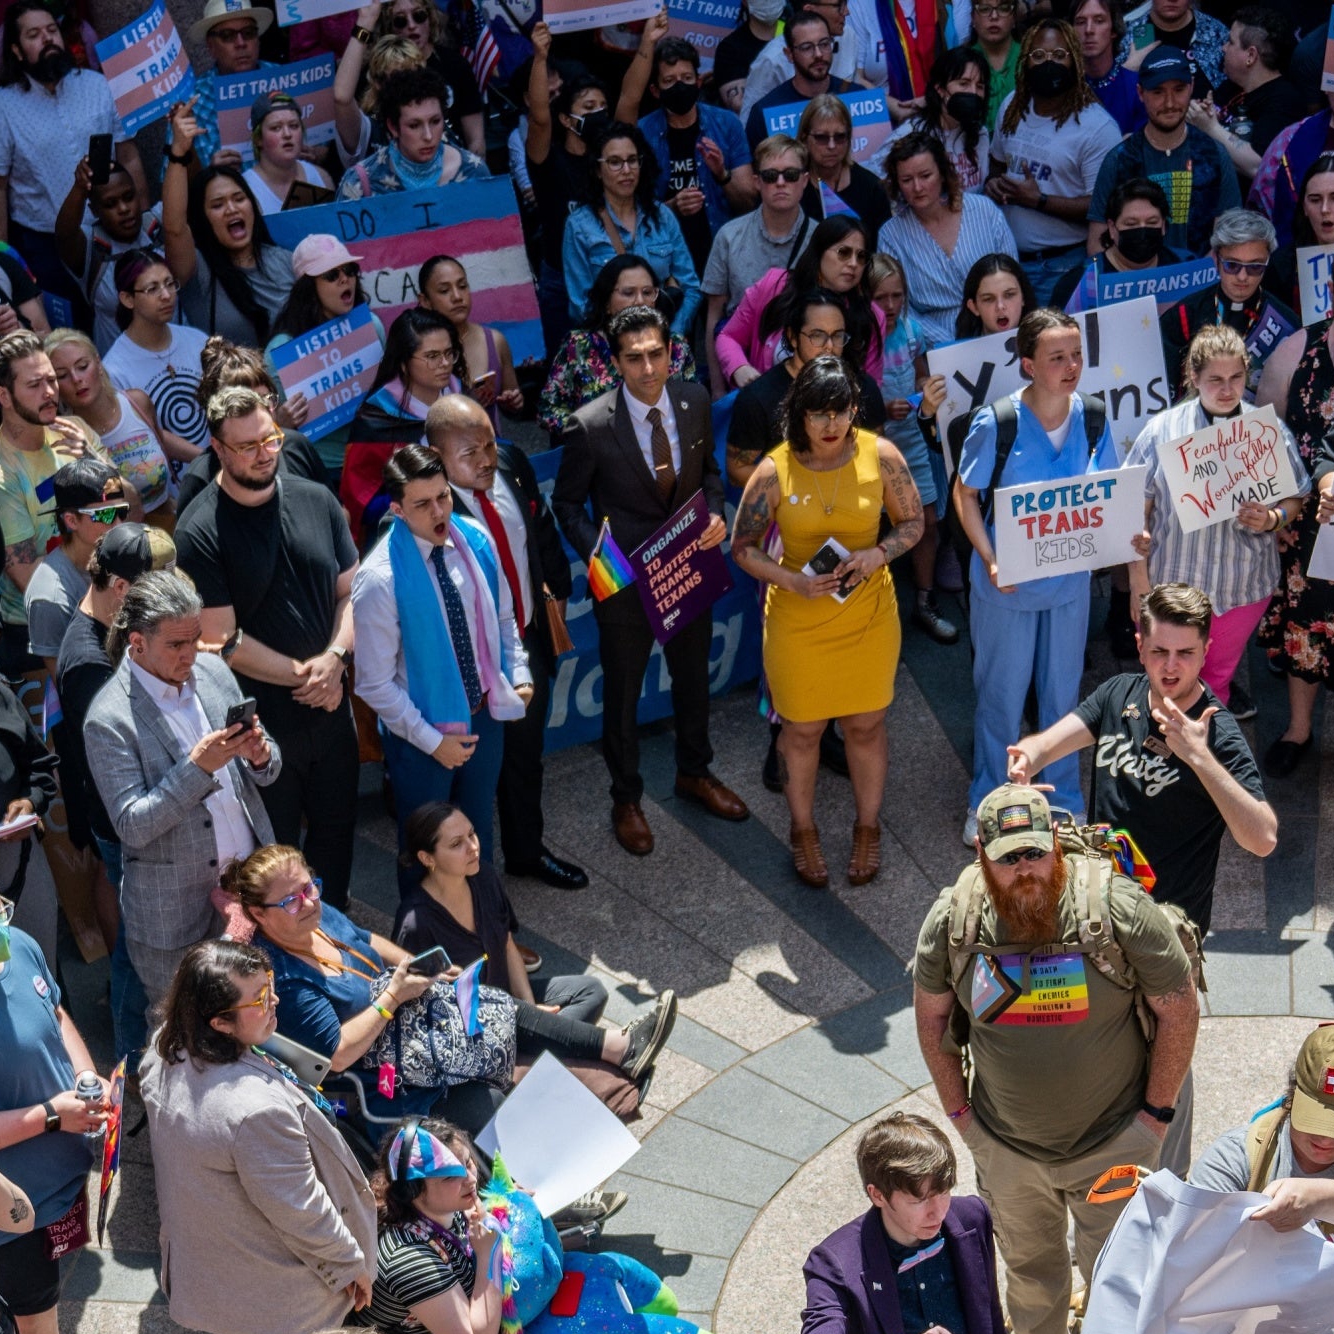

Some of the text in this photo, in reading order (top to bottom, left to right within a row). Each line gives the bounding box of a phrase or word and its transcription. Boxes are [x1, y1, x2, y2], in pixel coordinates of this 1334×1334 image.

[697, 3, 741, 20] TRANS
[147, 32, 167, 53] TO
[136, 46, 178, 84] TRANS
[152, 65, 184, 99] KIDS
[219, 63, 332, 100] LET TRANS KIDS
[770, 98, 884, 132] LET KIDS
[338, 210, 376, 242] DO
[1103, 280, 1135, 300] LET
[1137, 274, 1189, 297] TRANS
[295, 319, 352, 359] LISTEN
[1259, 317, 1281, 347] BE
[310, 358, 364, 396] TRANS
[318, 349, 341, 371] TO
[323, 382, 363, 413] KIDS
[1193, 460, 1218, 482] AND
[1011, 479, 1117, 518] PROTECT
[642, 508, 697, 564] ORGANIZE
[1018, 506, 1104, 540] TRANS
[649, 538, 699, 589] PROTECT
[1035, 533, 1098, 567] KIDS.
[645, 558, 662, 577] TO
[651, 562, 692, 601] TRANS
[656, 571, 703, 614] TEXANS
[1096, 733, 1180, 797] Unity
[1038, 990, 1070, 1001] ENEMIES
[47, 1216, 77, 1235] TRANS
[51, 1223, 82, 1246] TEXANS
